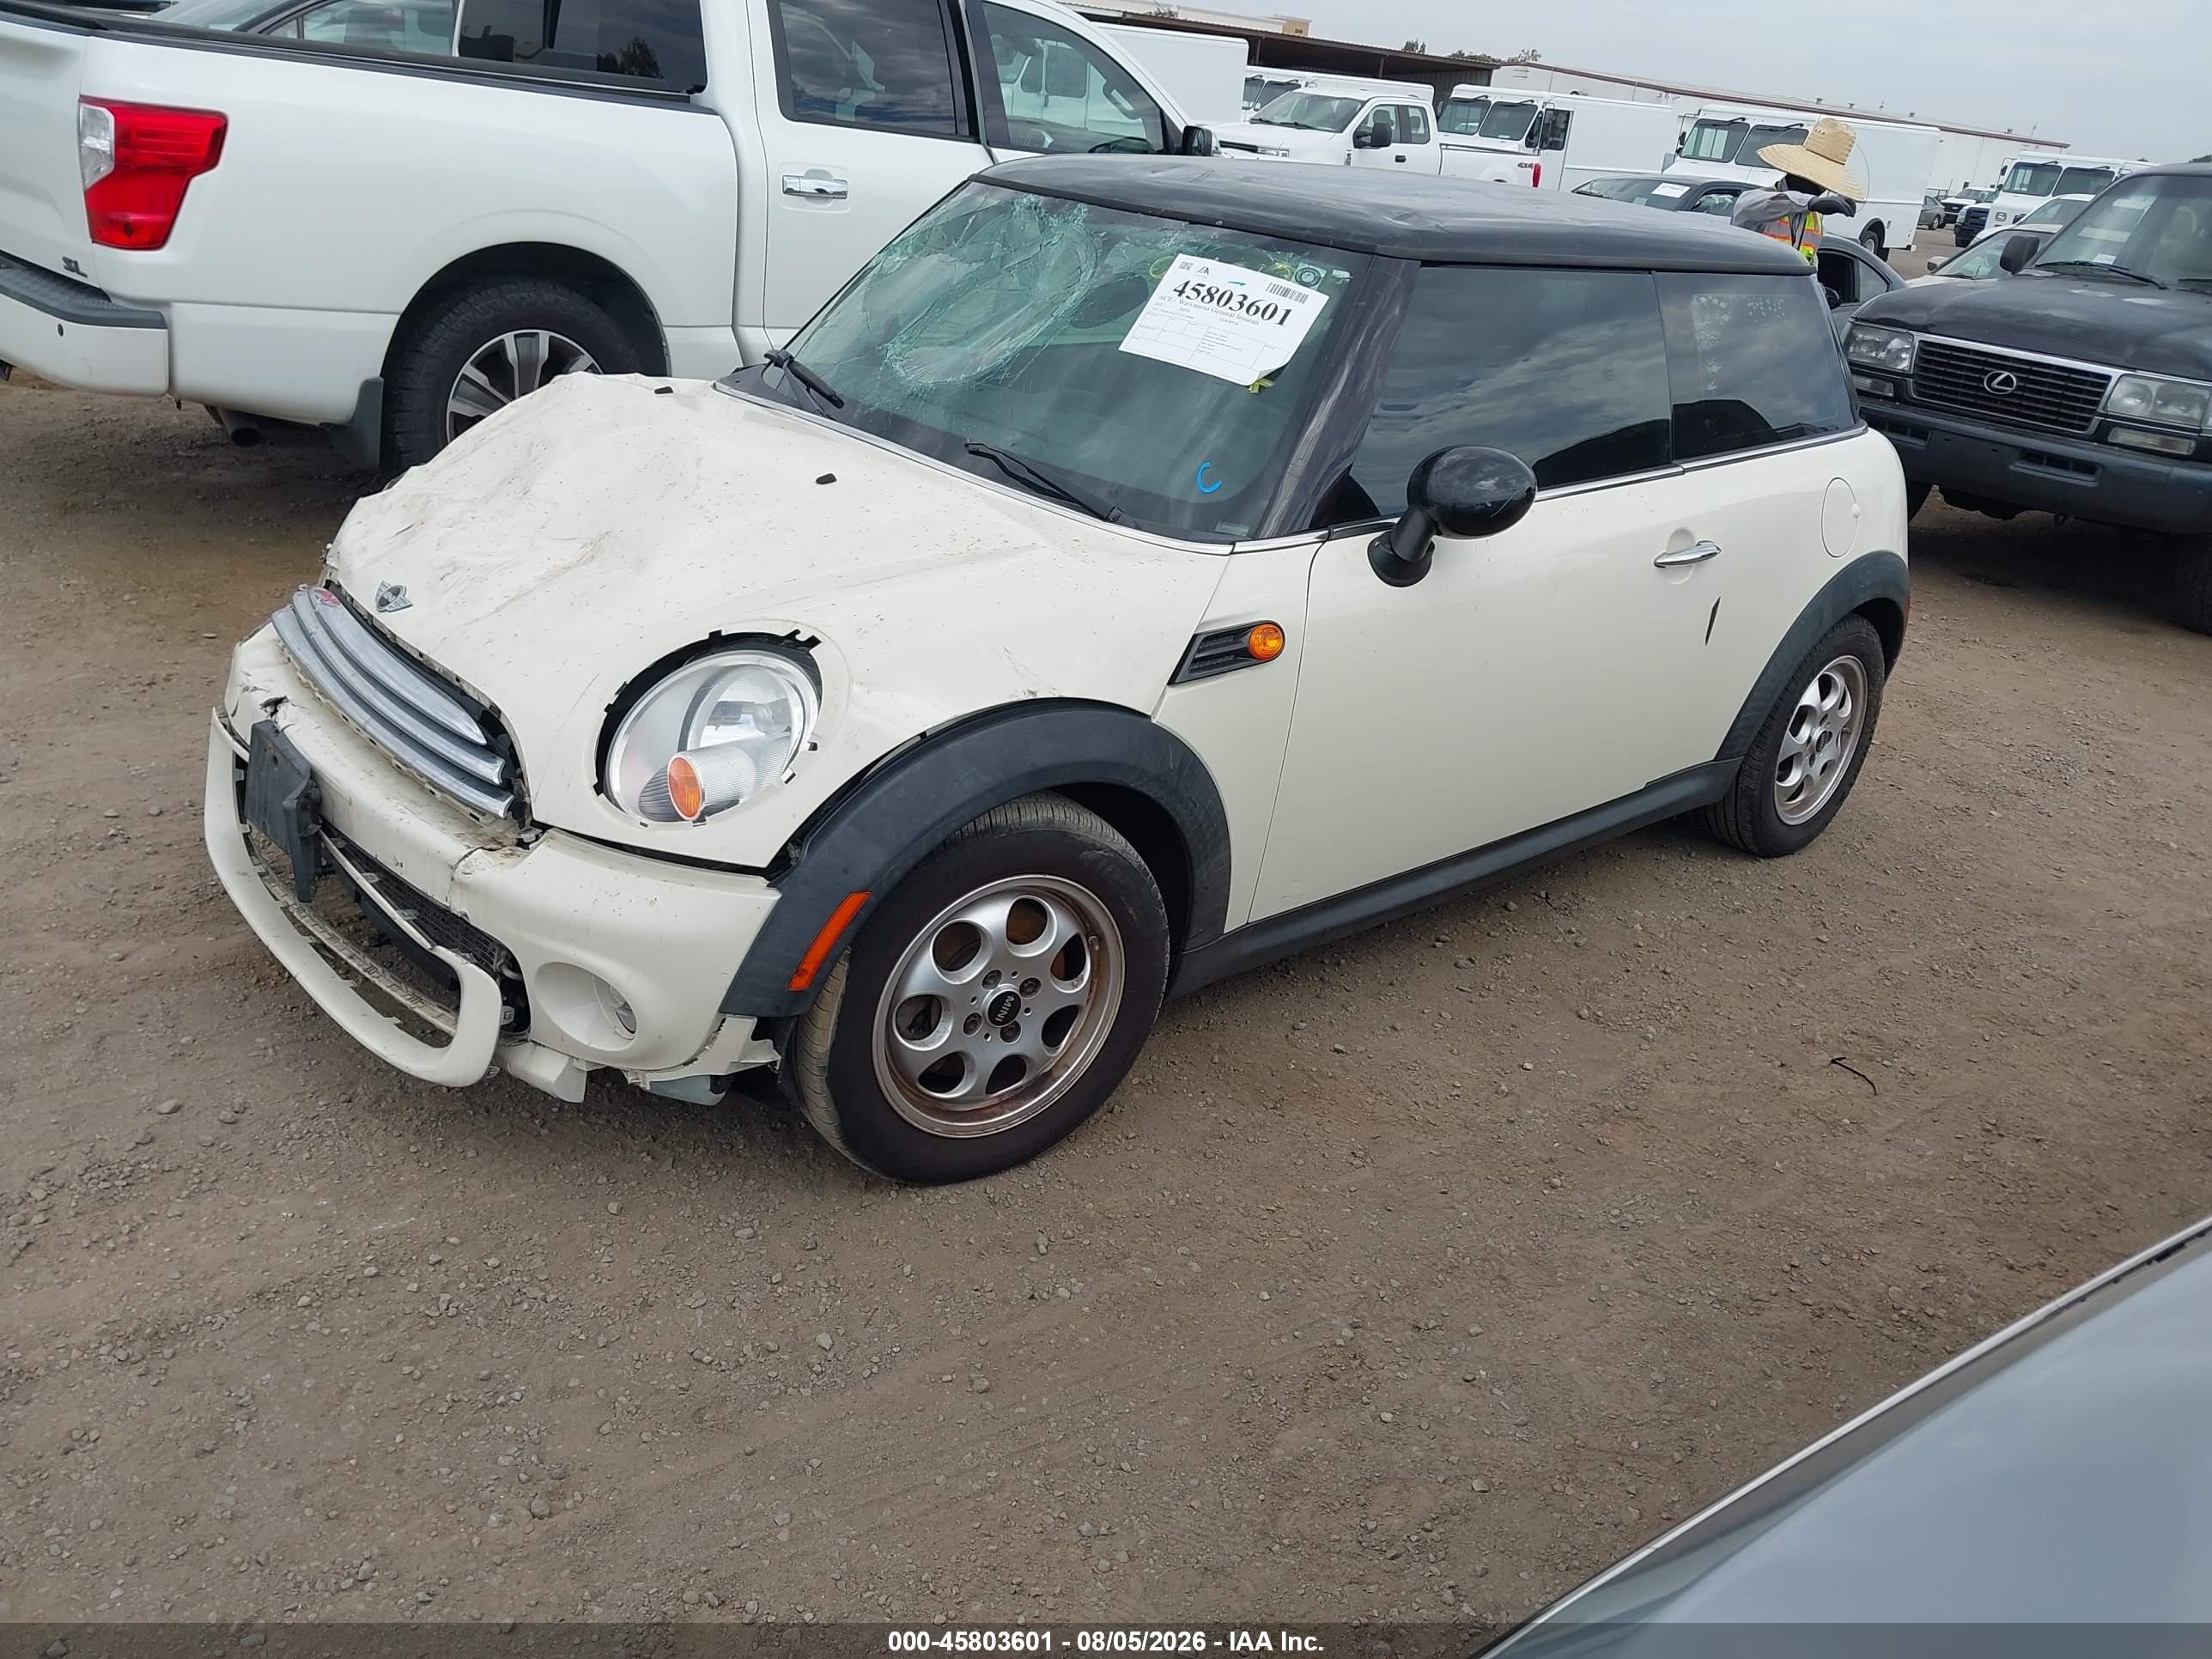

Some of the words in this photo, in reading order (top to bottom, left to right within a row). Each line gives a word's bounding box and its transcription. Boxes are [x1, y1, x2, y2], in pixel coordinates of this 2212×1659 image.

[62, 256, 88, 278] SL
[1173, 280, 1292, 326] 45803601
[1211, 307, 1235, 319] General
[994, 995, 1015, 1023] MINI
